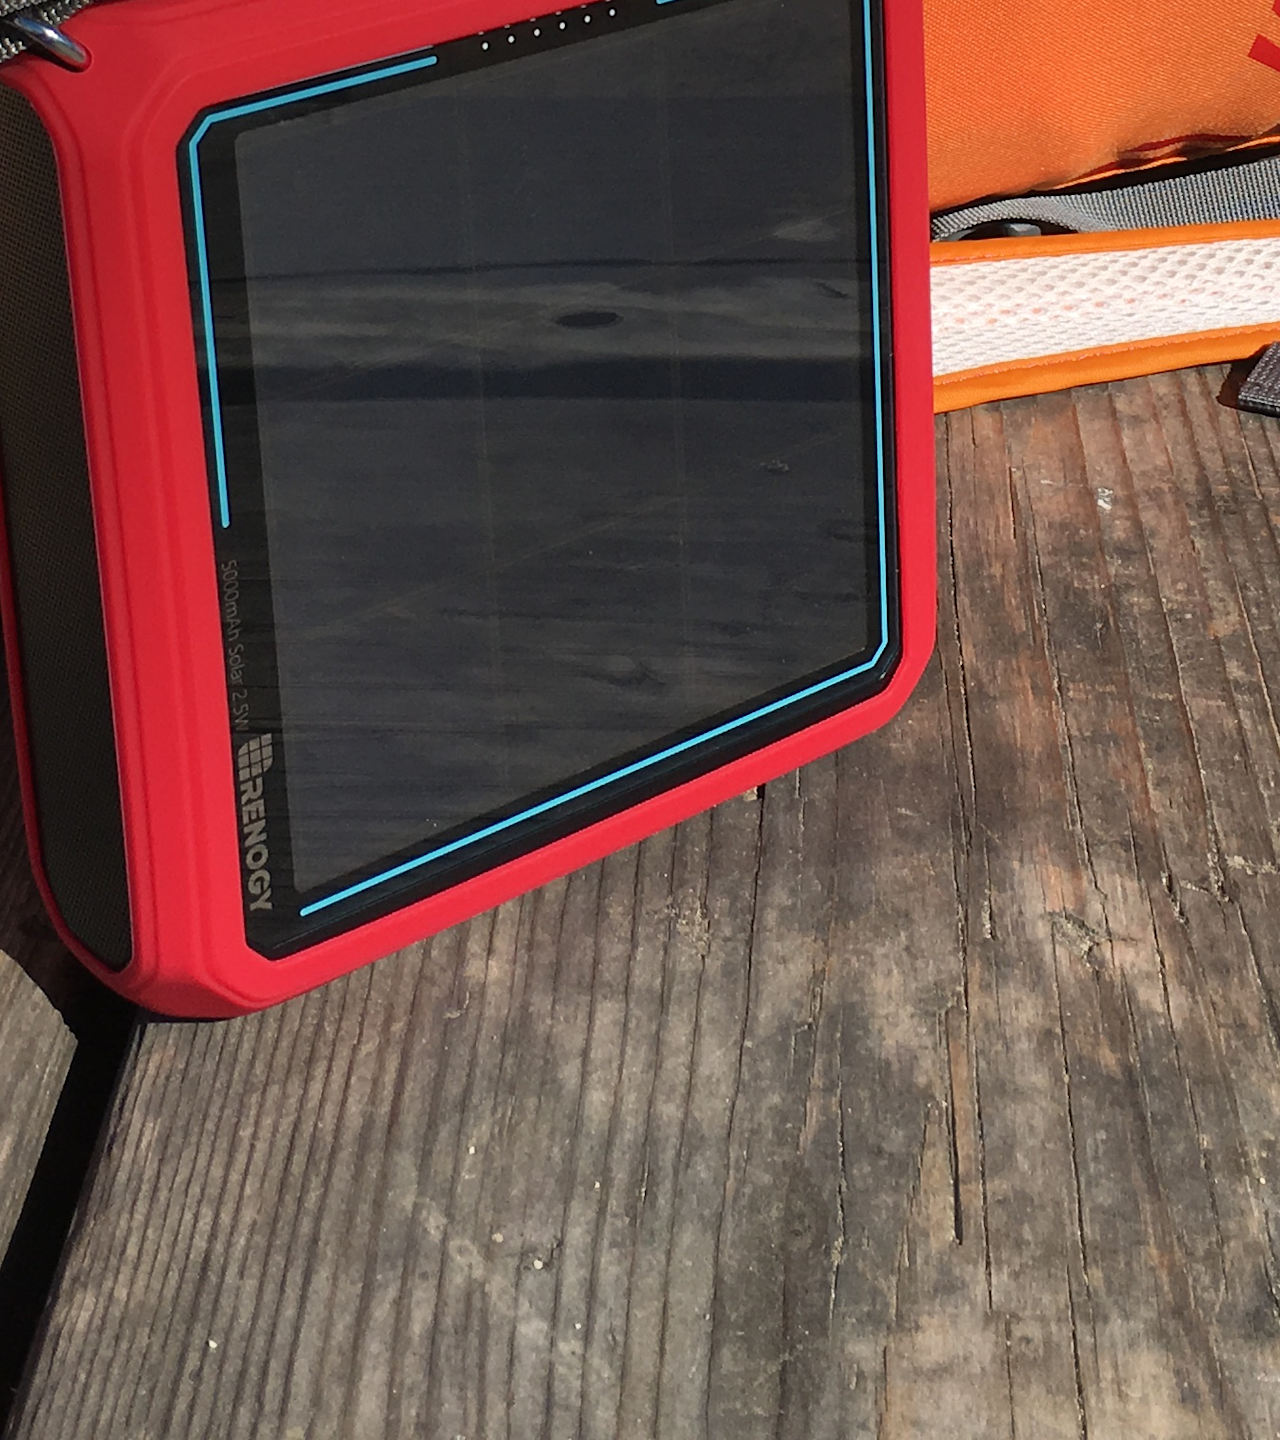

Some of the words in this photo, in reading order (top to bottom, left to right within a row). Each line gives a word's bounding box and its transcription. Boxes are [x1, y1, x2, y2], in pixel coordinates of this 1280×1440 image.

[221, 559, 242, 641] 5000mAh
[228, 644, 246, 687] Solar
[231, 689, 249, 732] 25W
[240, 777, 273, 911] RENOGY
